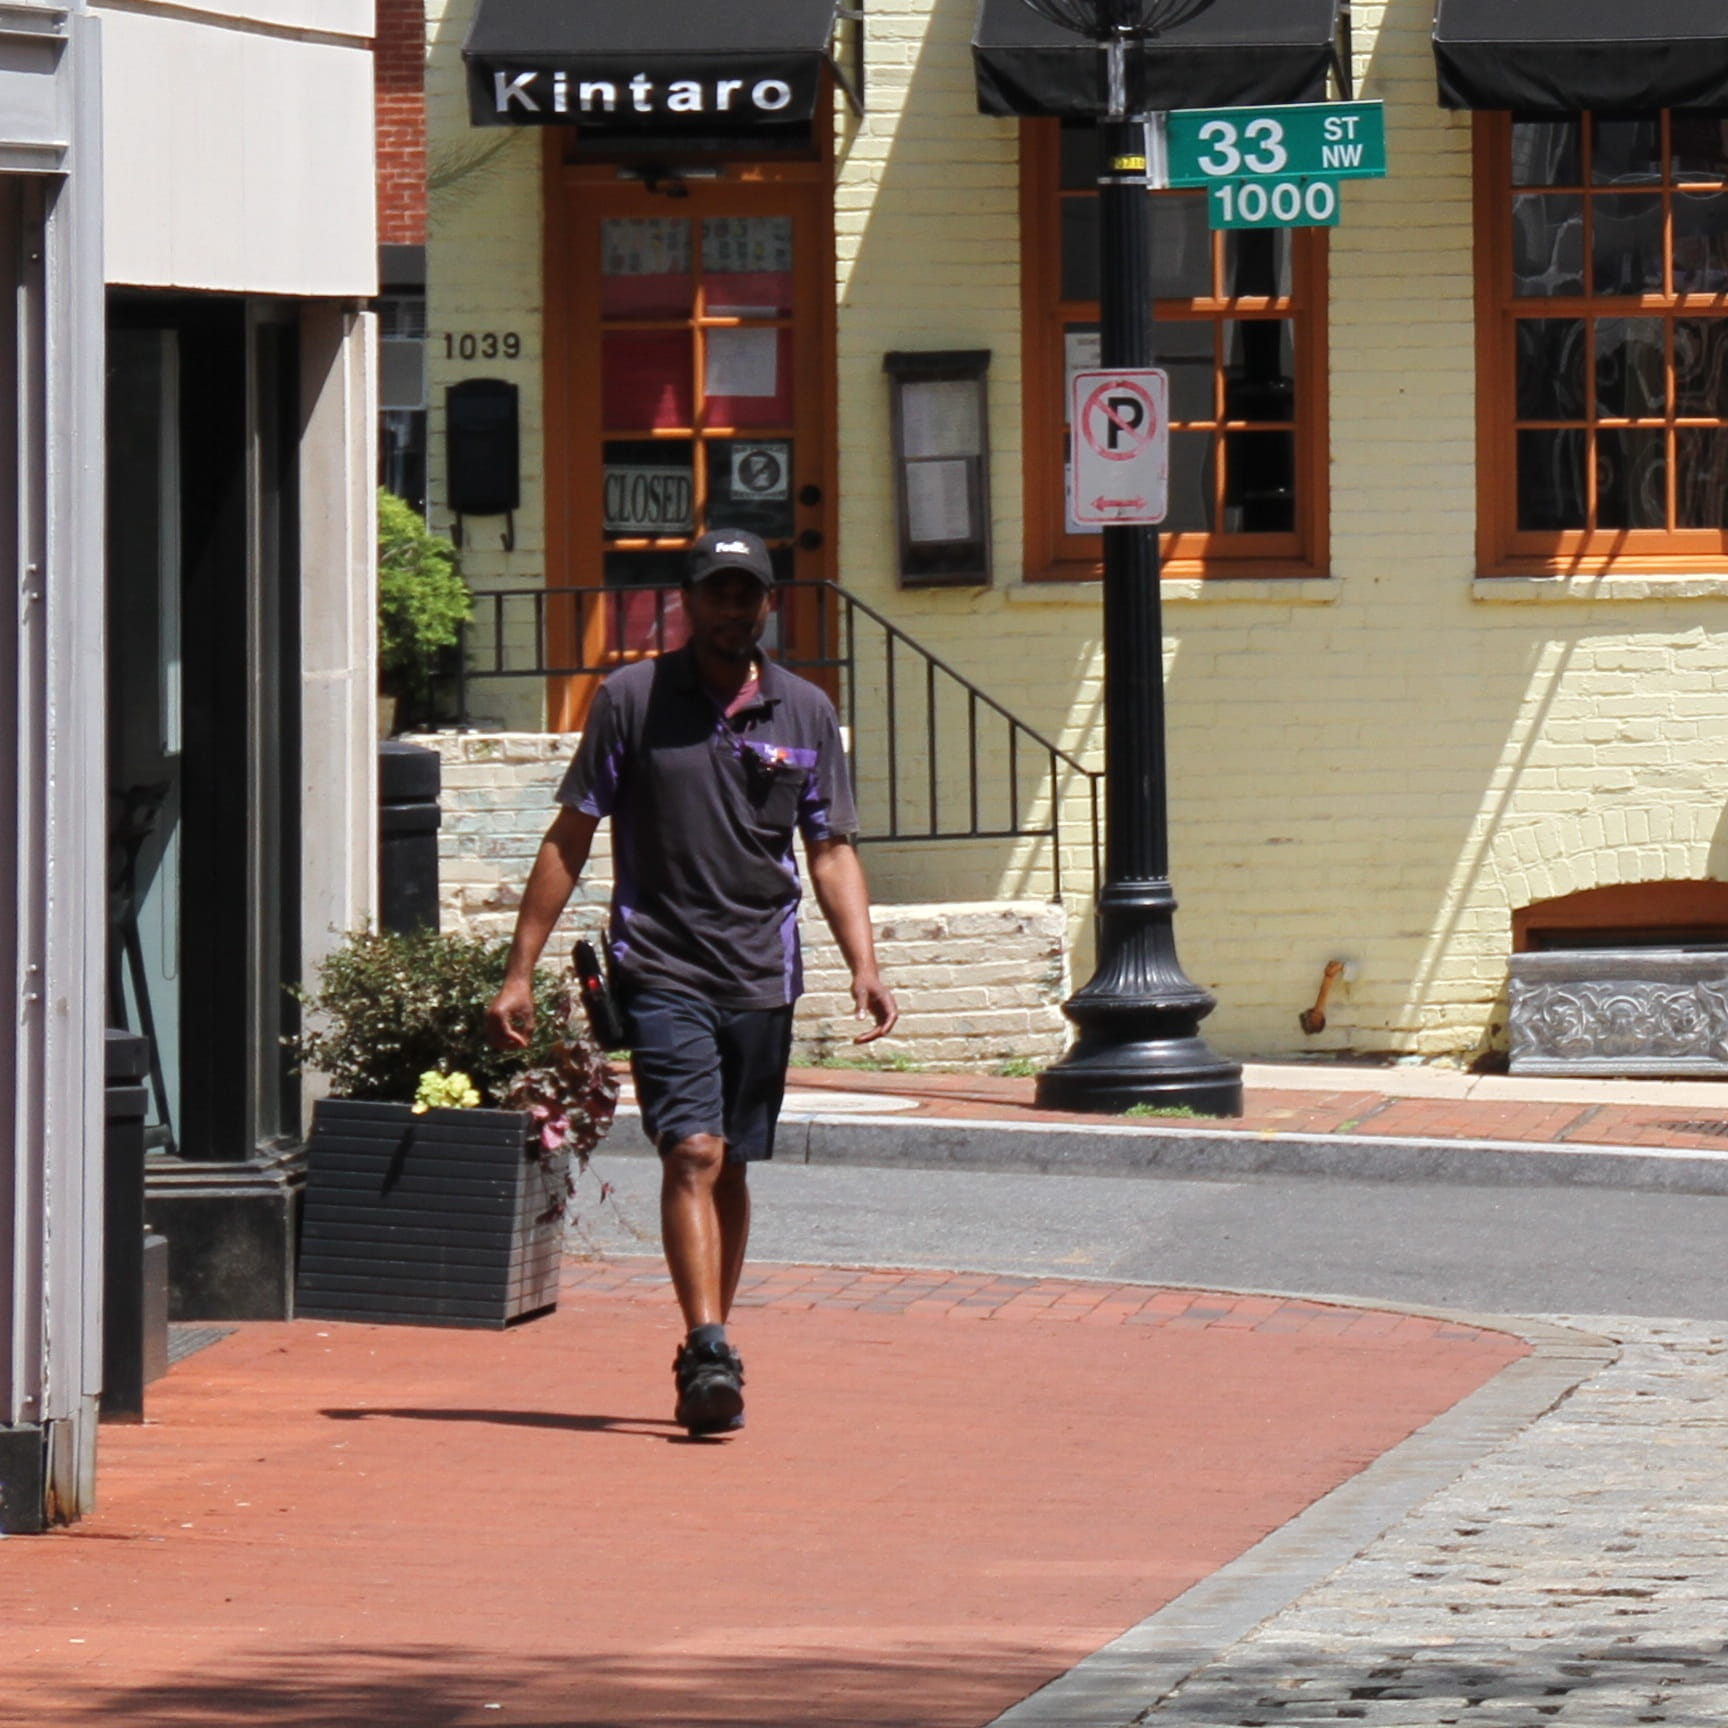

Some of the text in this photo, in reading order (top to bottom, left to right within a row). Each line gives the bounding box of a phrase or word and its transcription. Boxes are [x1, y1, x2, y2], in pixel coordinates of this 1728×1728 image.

[494, 72, 791, 113] Kintaro
[1197, 117, 1360, 176] 33 ST
[1321, 144, 1363, 168] NW
[1214, 182, 1335, 222] 1000
[442, 331, 522, 361] 1039
[1107, 396, 1145, 450] P
[604, 473, 692, 524] CLOSED
